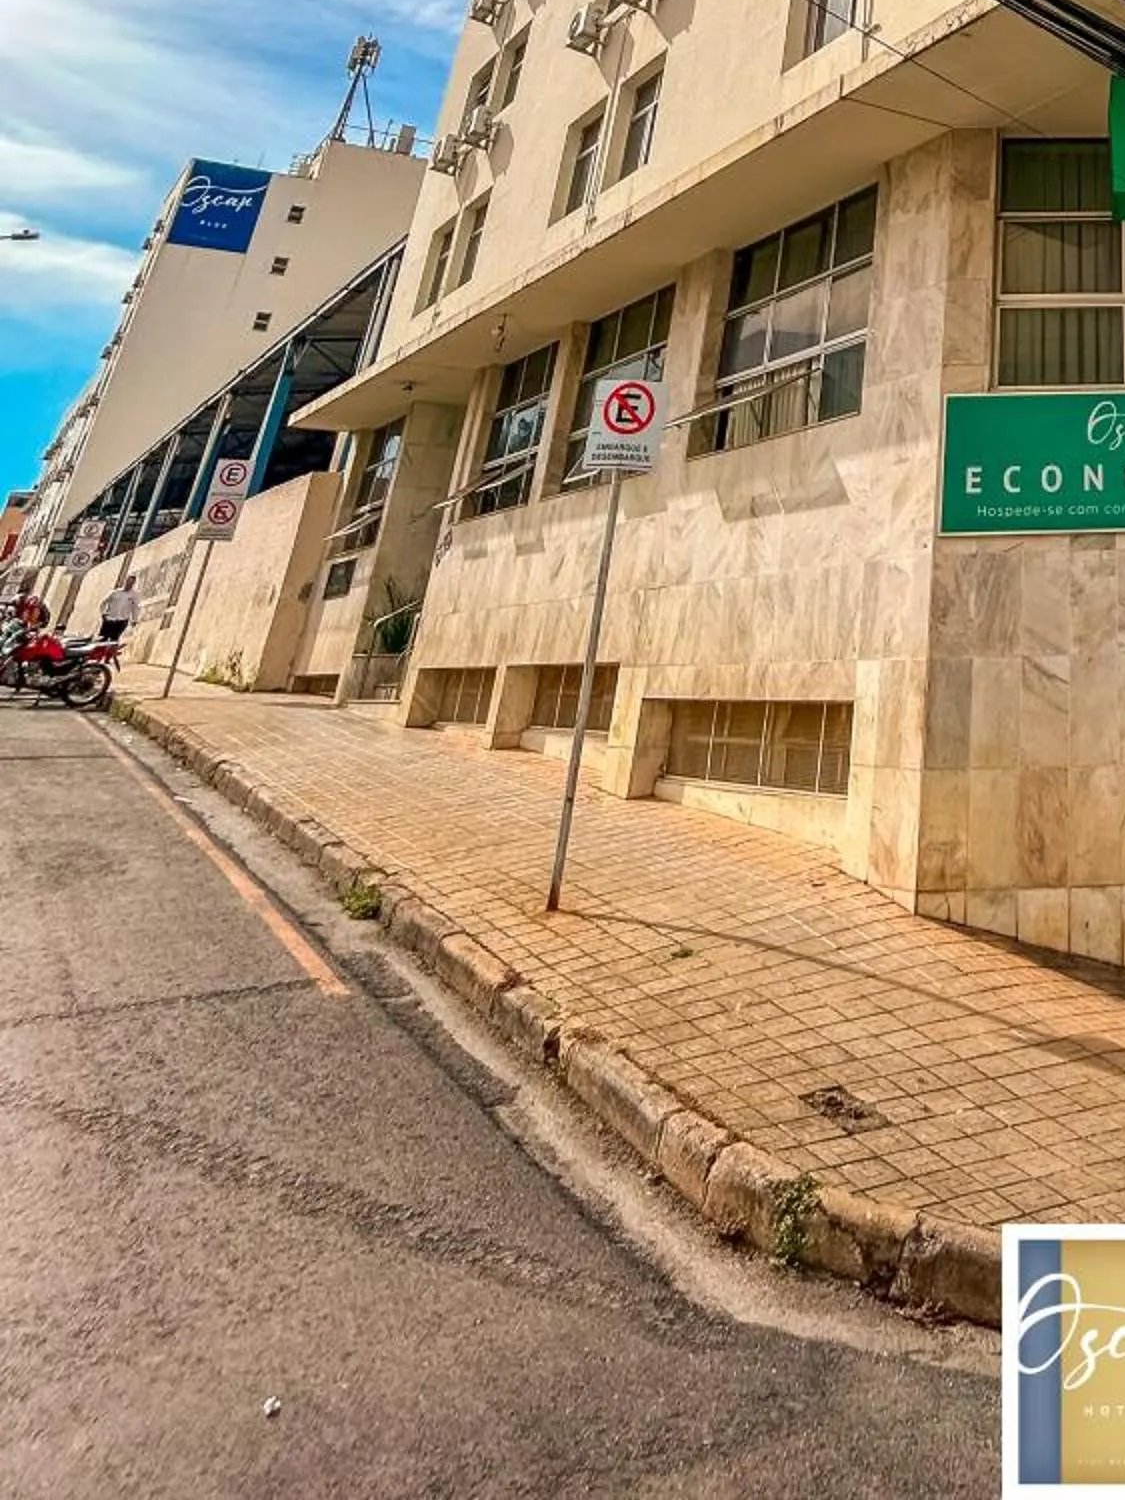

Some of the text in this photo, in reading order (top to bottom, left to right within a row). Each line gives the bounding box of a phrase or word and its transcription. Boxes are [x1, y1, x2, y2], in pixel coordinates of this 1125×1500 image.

[181, 175, 267, 215] Oscar
[976, 504, 1064, 518] Hospede-se
[1067, 504, 1099, 516] com
